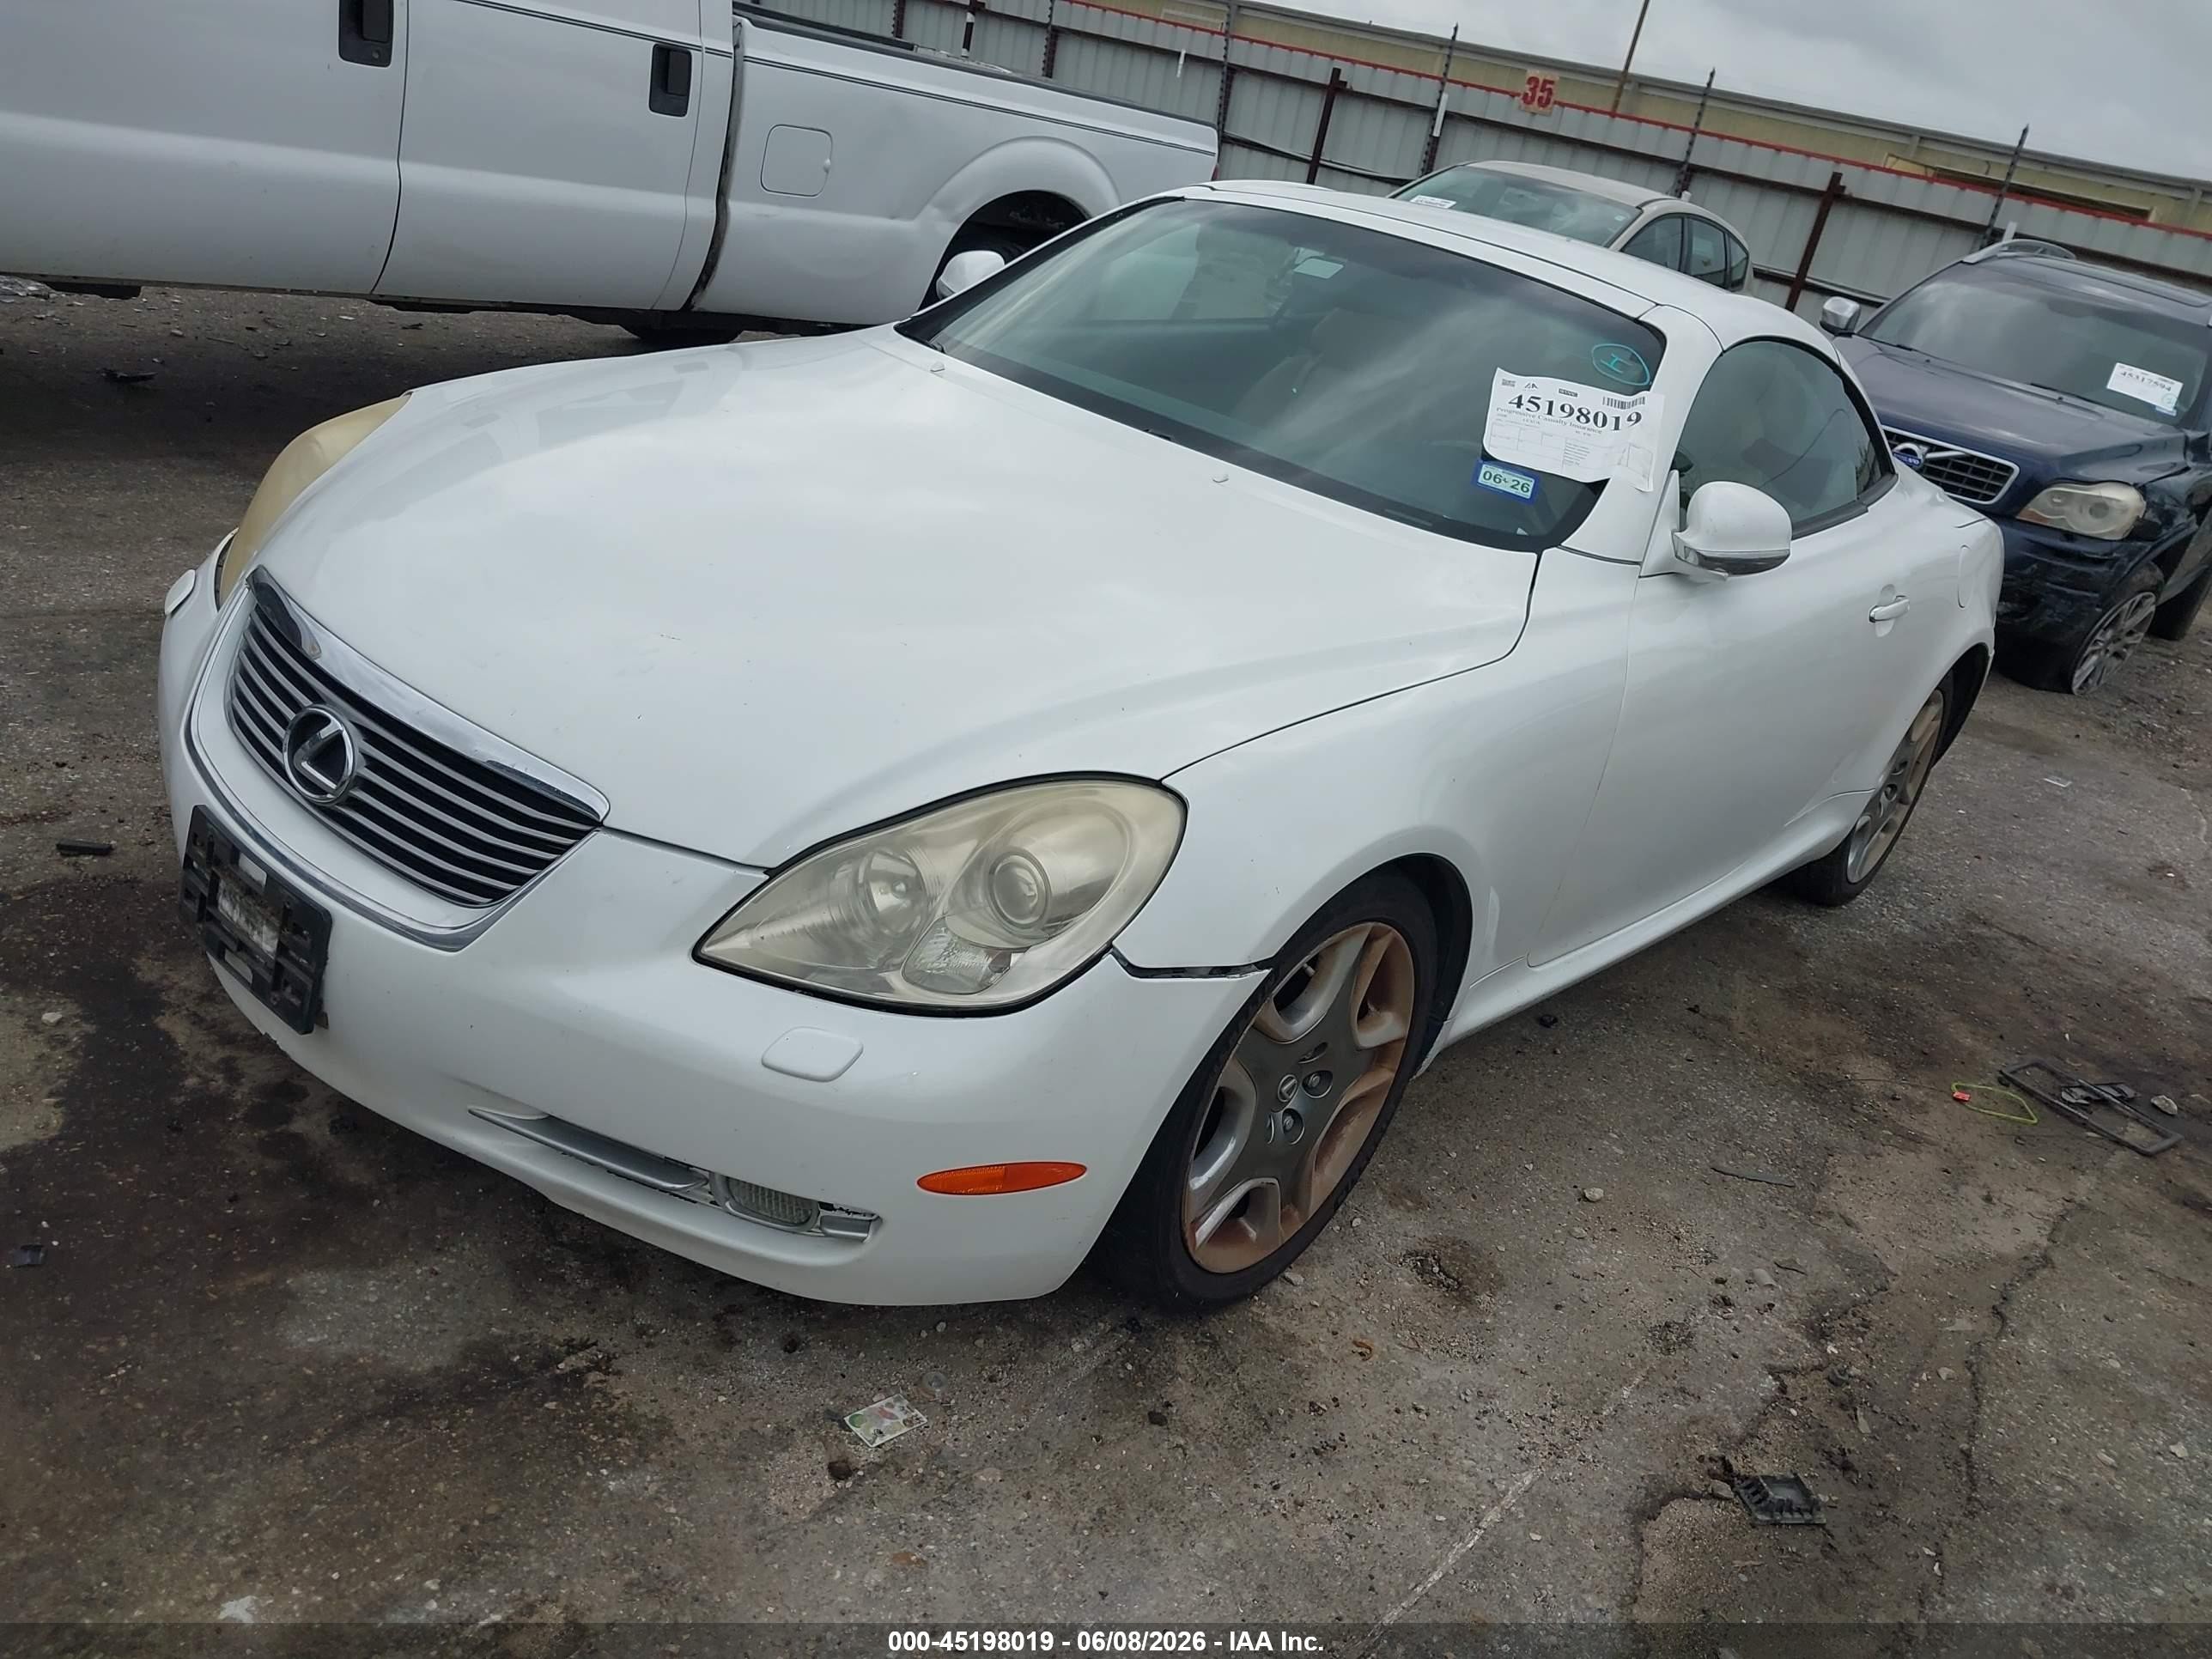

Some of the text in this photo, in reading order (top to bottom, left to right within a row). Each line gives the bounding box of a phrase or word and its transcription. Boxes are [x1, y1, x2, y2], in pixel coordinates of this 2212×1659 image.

[1522, 76, 1555, 108] 35
[1497, 407, 1537, 419] Progressive
[1538, 414, 1569, 426] Casualty
[1569, 421, 1602, 434] Insurance
[1508, 394, 1642, 431] 45198019
[1483, 471, 1503, 483] 06
[1510, 479, 1530, 493] 26
